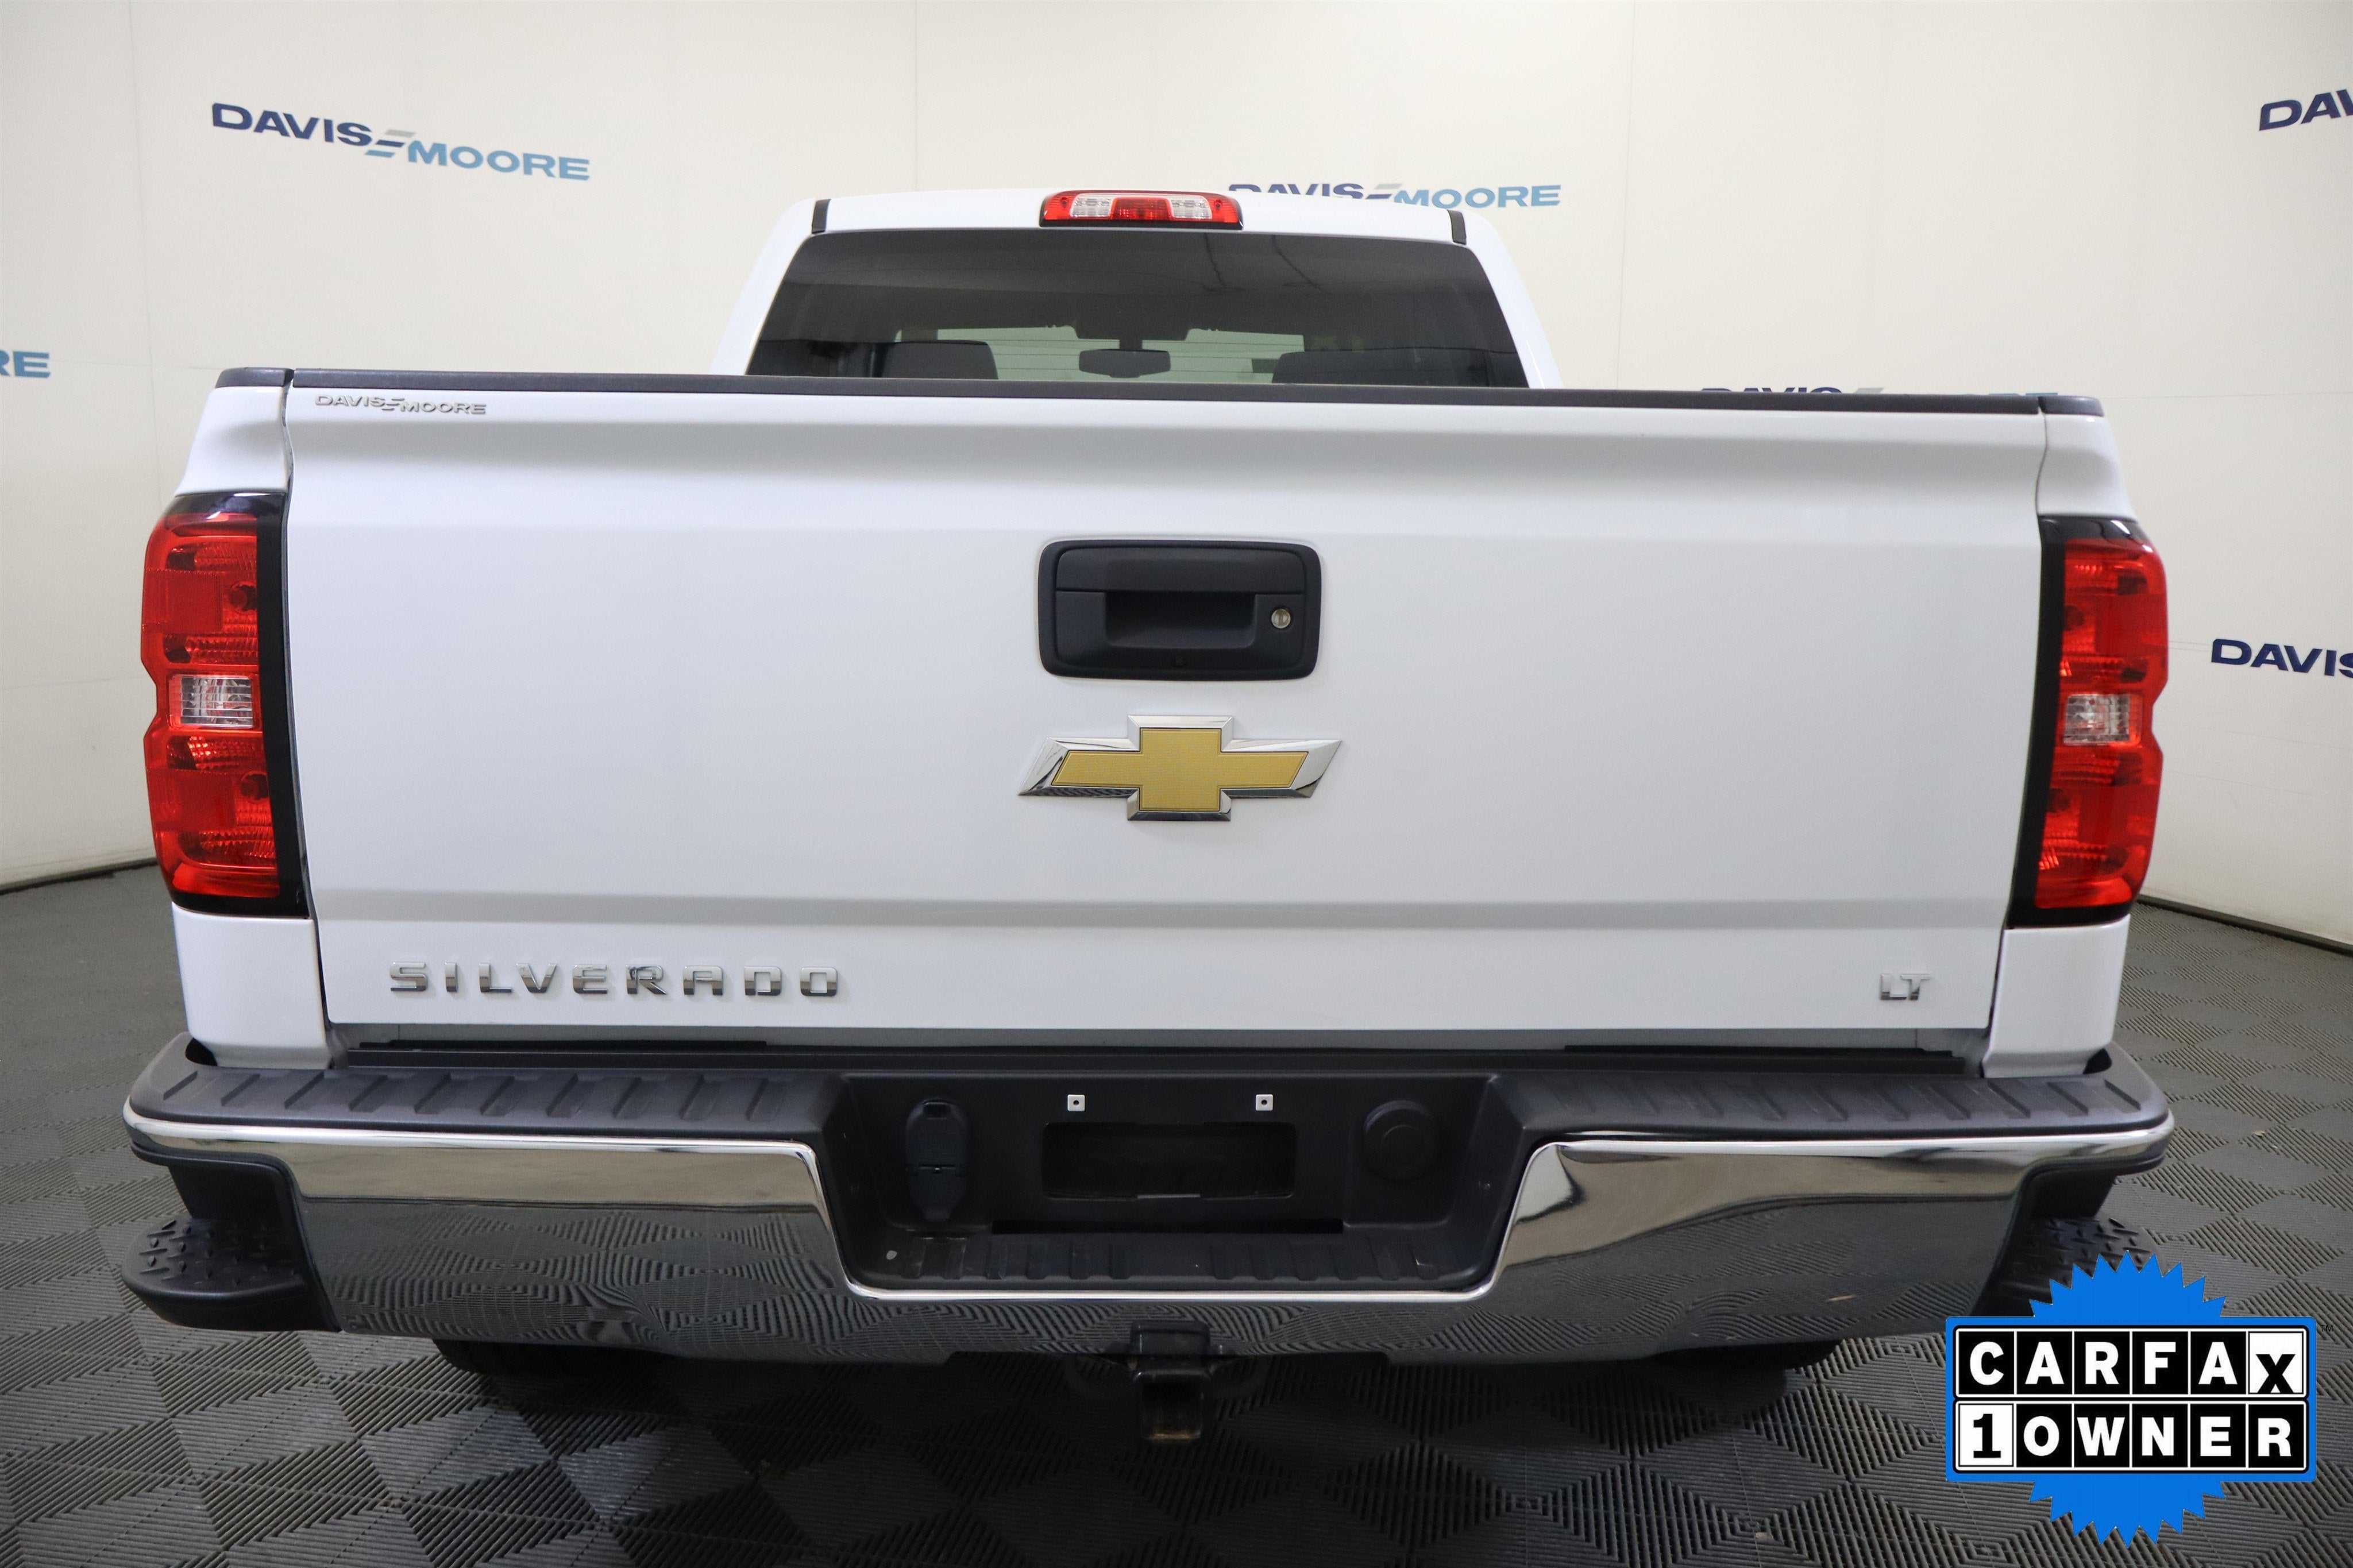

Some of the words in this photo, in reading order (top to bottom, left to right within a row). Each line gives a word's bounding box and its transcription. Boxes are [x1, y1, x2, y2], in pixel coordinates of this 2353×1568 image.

[212, 103, 372, 146] DAVIS
[407, 140, 590, 181] MOORE
[315, 396, 385, 407] DAVIS
[400, 401, 487, 414] MOORE
[389, 961, 839, 997] SILVERADO
[1880, 974, 1931, 1001] LT
